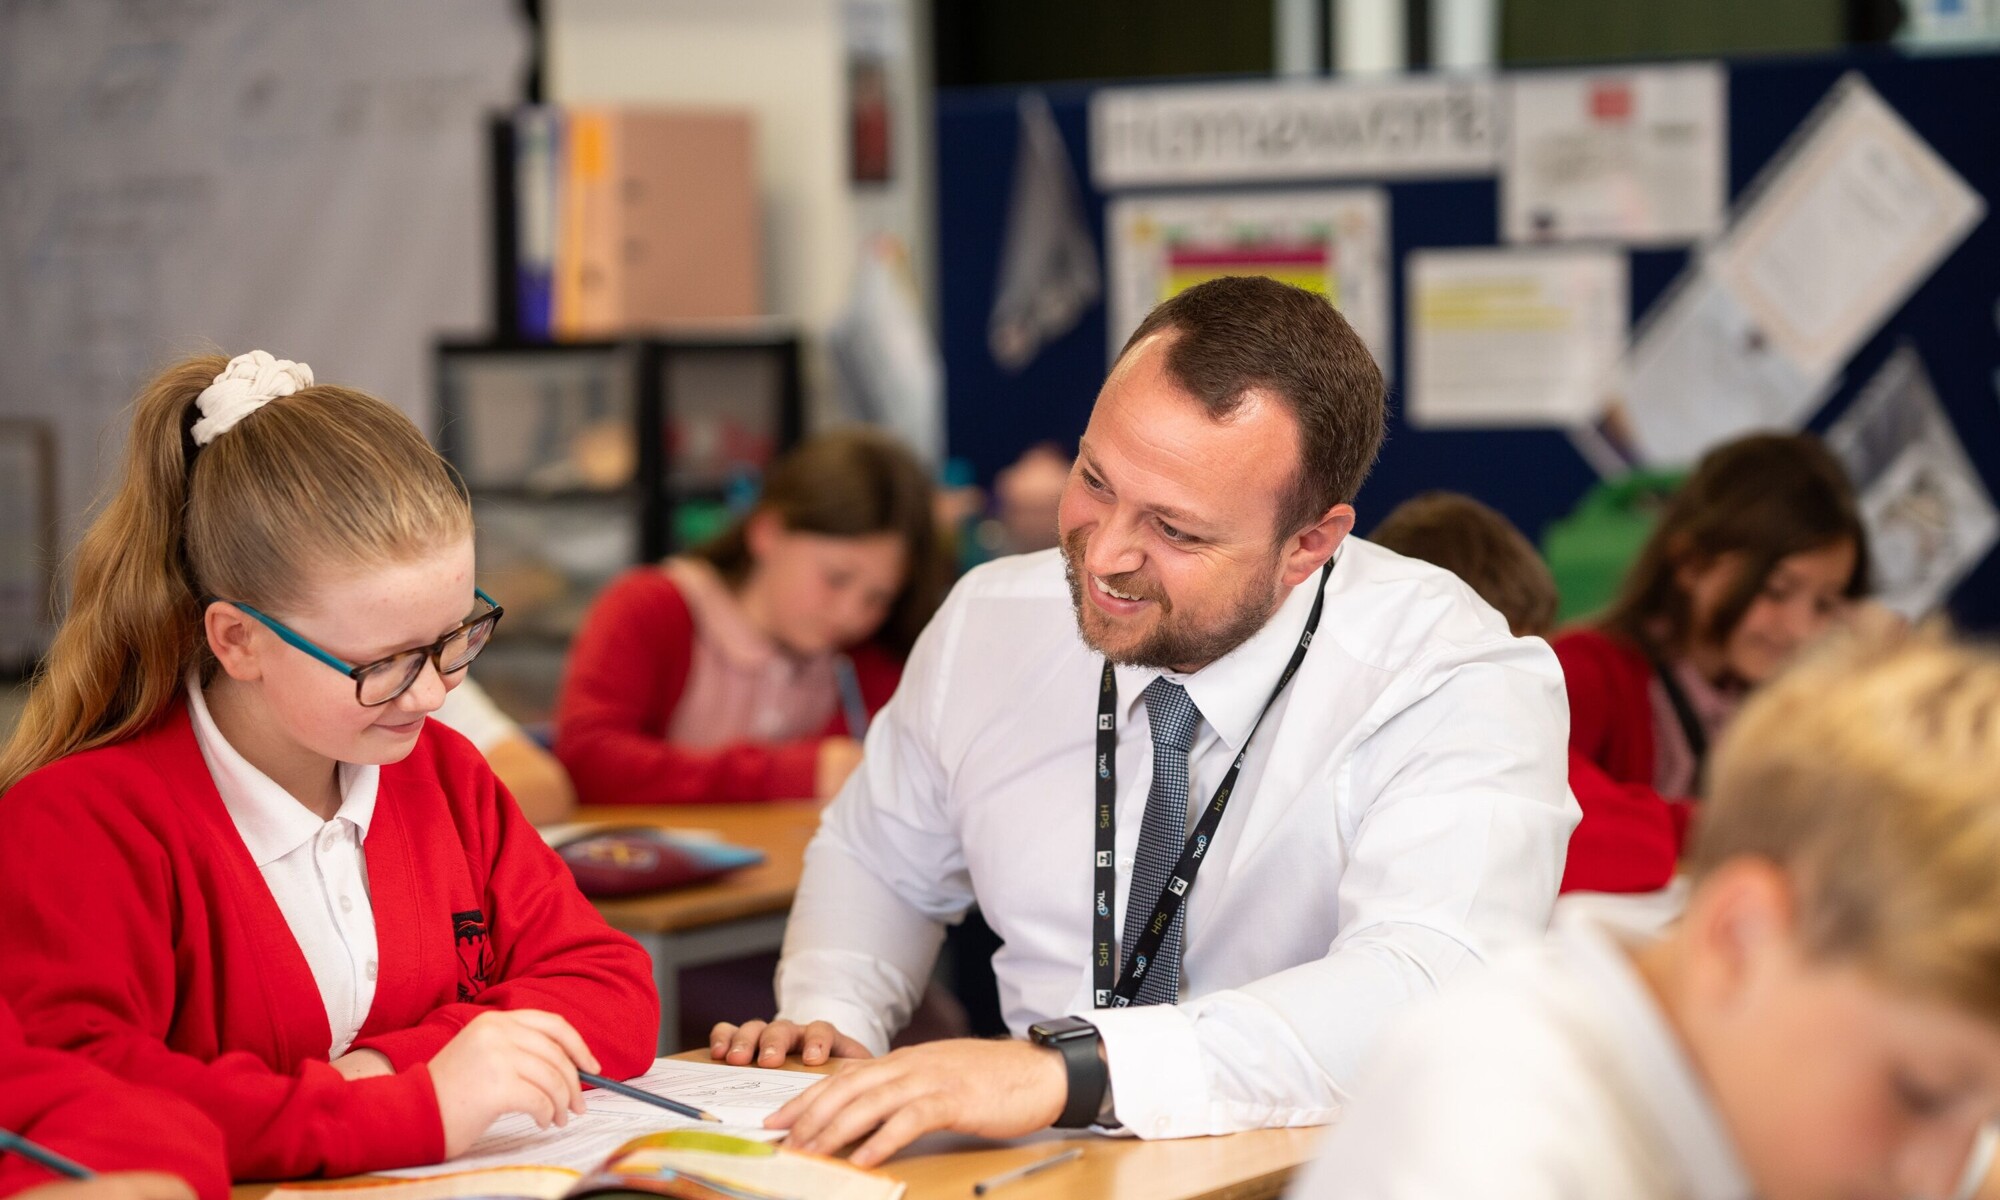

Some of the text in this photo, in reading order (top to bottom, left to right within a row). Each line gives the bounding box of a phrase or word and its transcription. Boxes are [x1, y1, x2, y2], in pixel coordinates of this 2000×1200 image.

[1213, 788, 1229, 812] HPS
[1100, 804, 1110, 829] HPS
[1192, 837, 1207, 859] TKAT
[1097, 890, 1106, 913] TKAT
[1151, 912, 1168, 935] HPS
[1099, 942, 1109, 967] HPS
